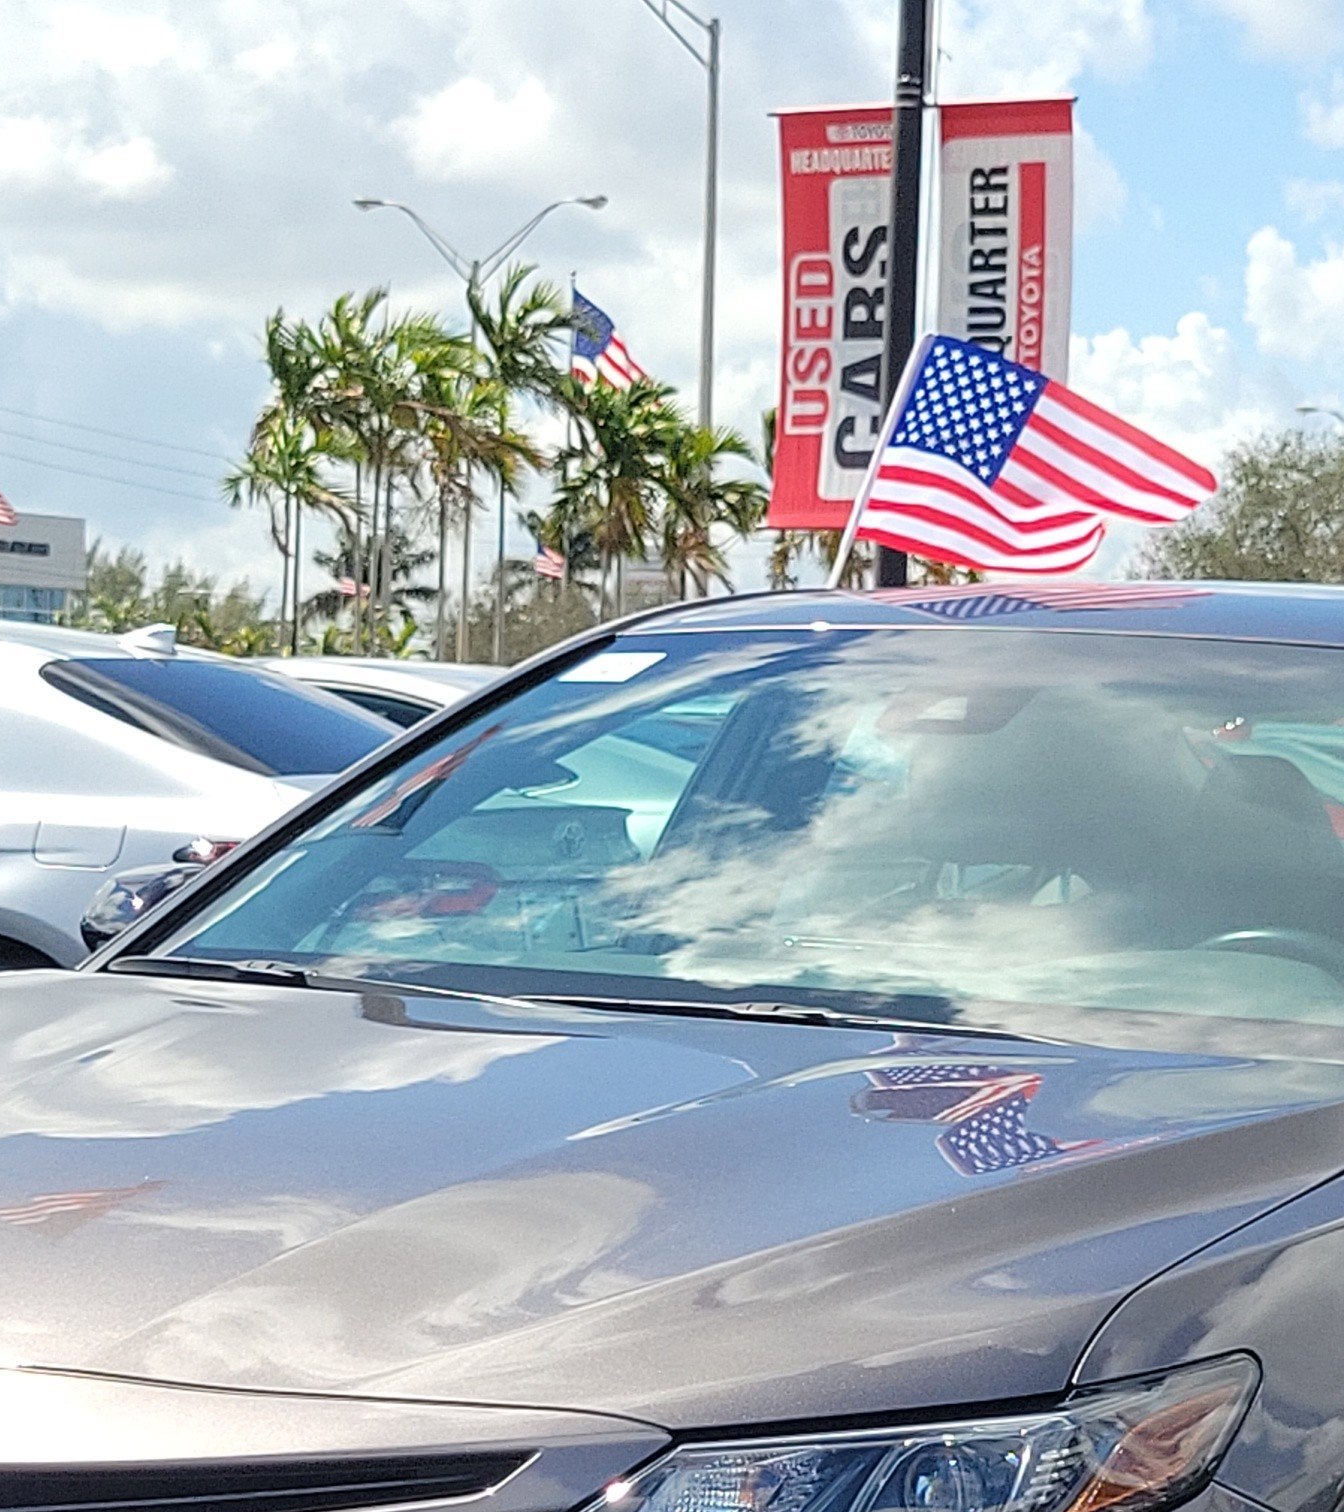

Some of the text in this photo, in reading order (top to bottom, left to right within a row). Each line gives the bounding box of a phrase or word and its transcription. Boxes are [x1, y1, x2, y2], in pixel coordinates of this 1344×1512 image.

[790, 146, 894, 174] HEADQUARTE
[852, 123, 895, 139] TOYOT
[789, 256, 835, 430] USED
[966, 165, 1013, 355] QUARTER
[834, 225, 888, 470] CARS
